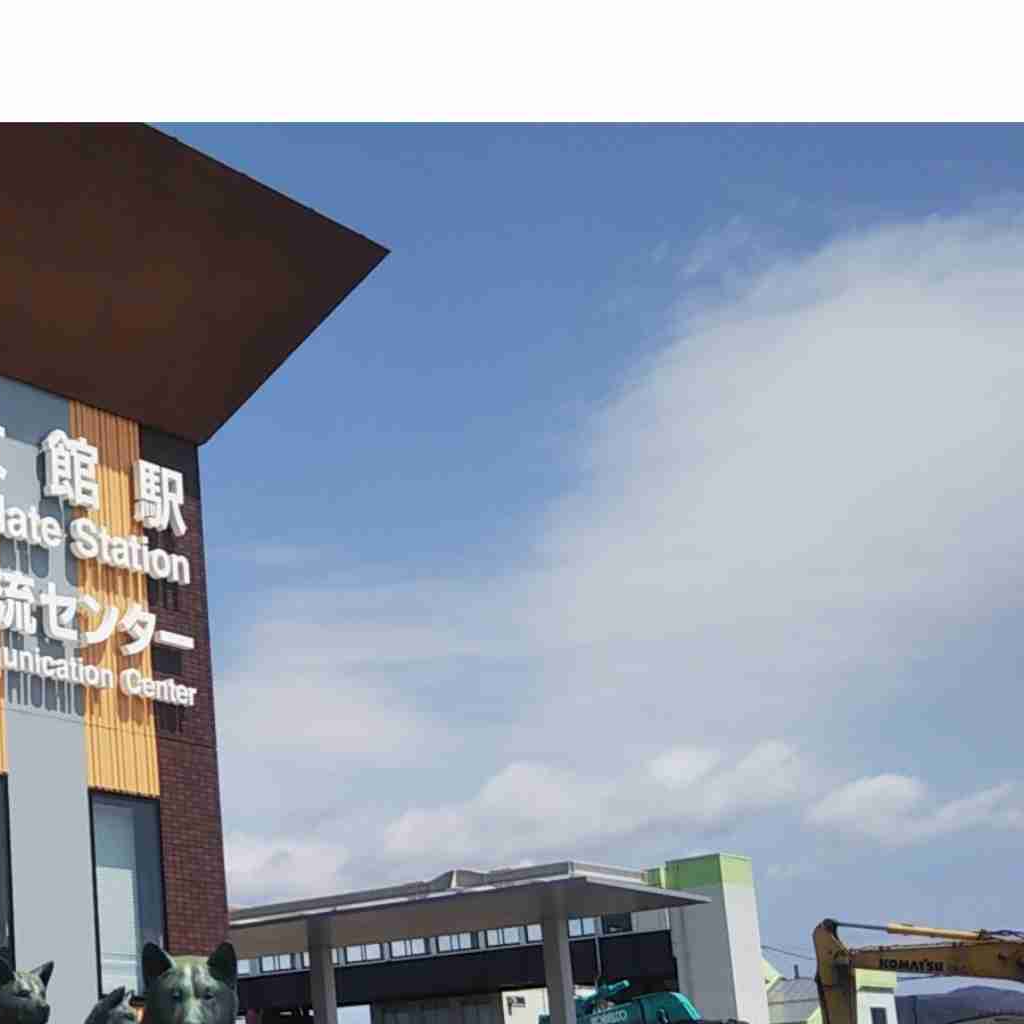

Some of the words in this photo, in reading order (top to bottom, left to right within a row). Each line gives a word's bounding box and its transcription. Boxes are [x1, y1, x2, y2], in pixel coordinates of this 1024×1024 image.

[70, 517, 191, 585] Station
[120, 667, 197, 707] Center
[879, 958, 944, 972] KOMATSU
